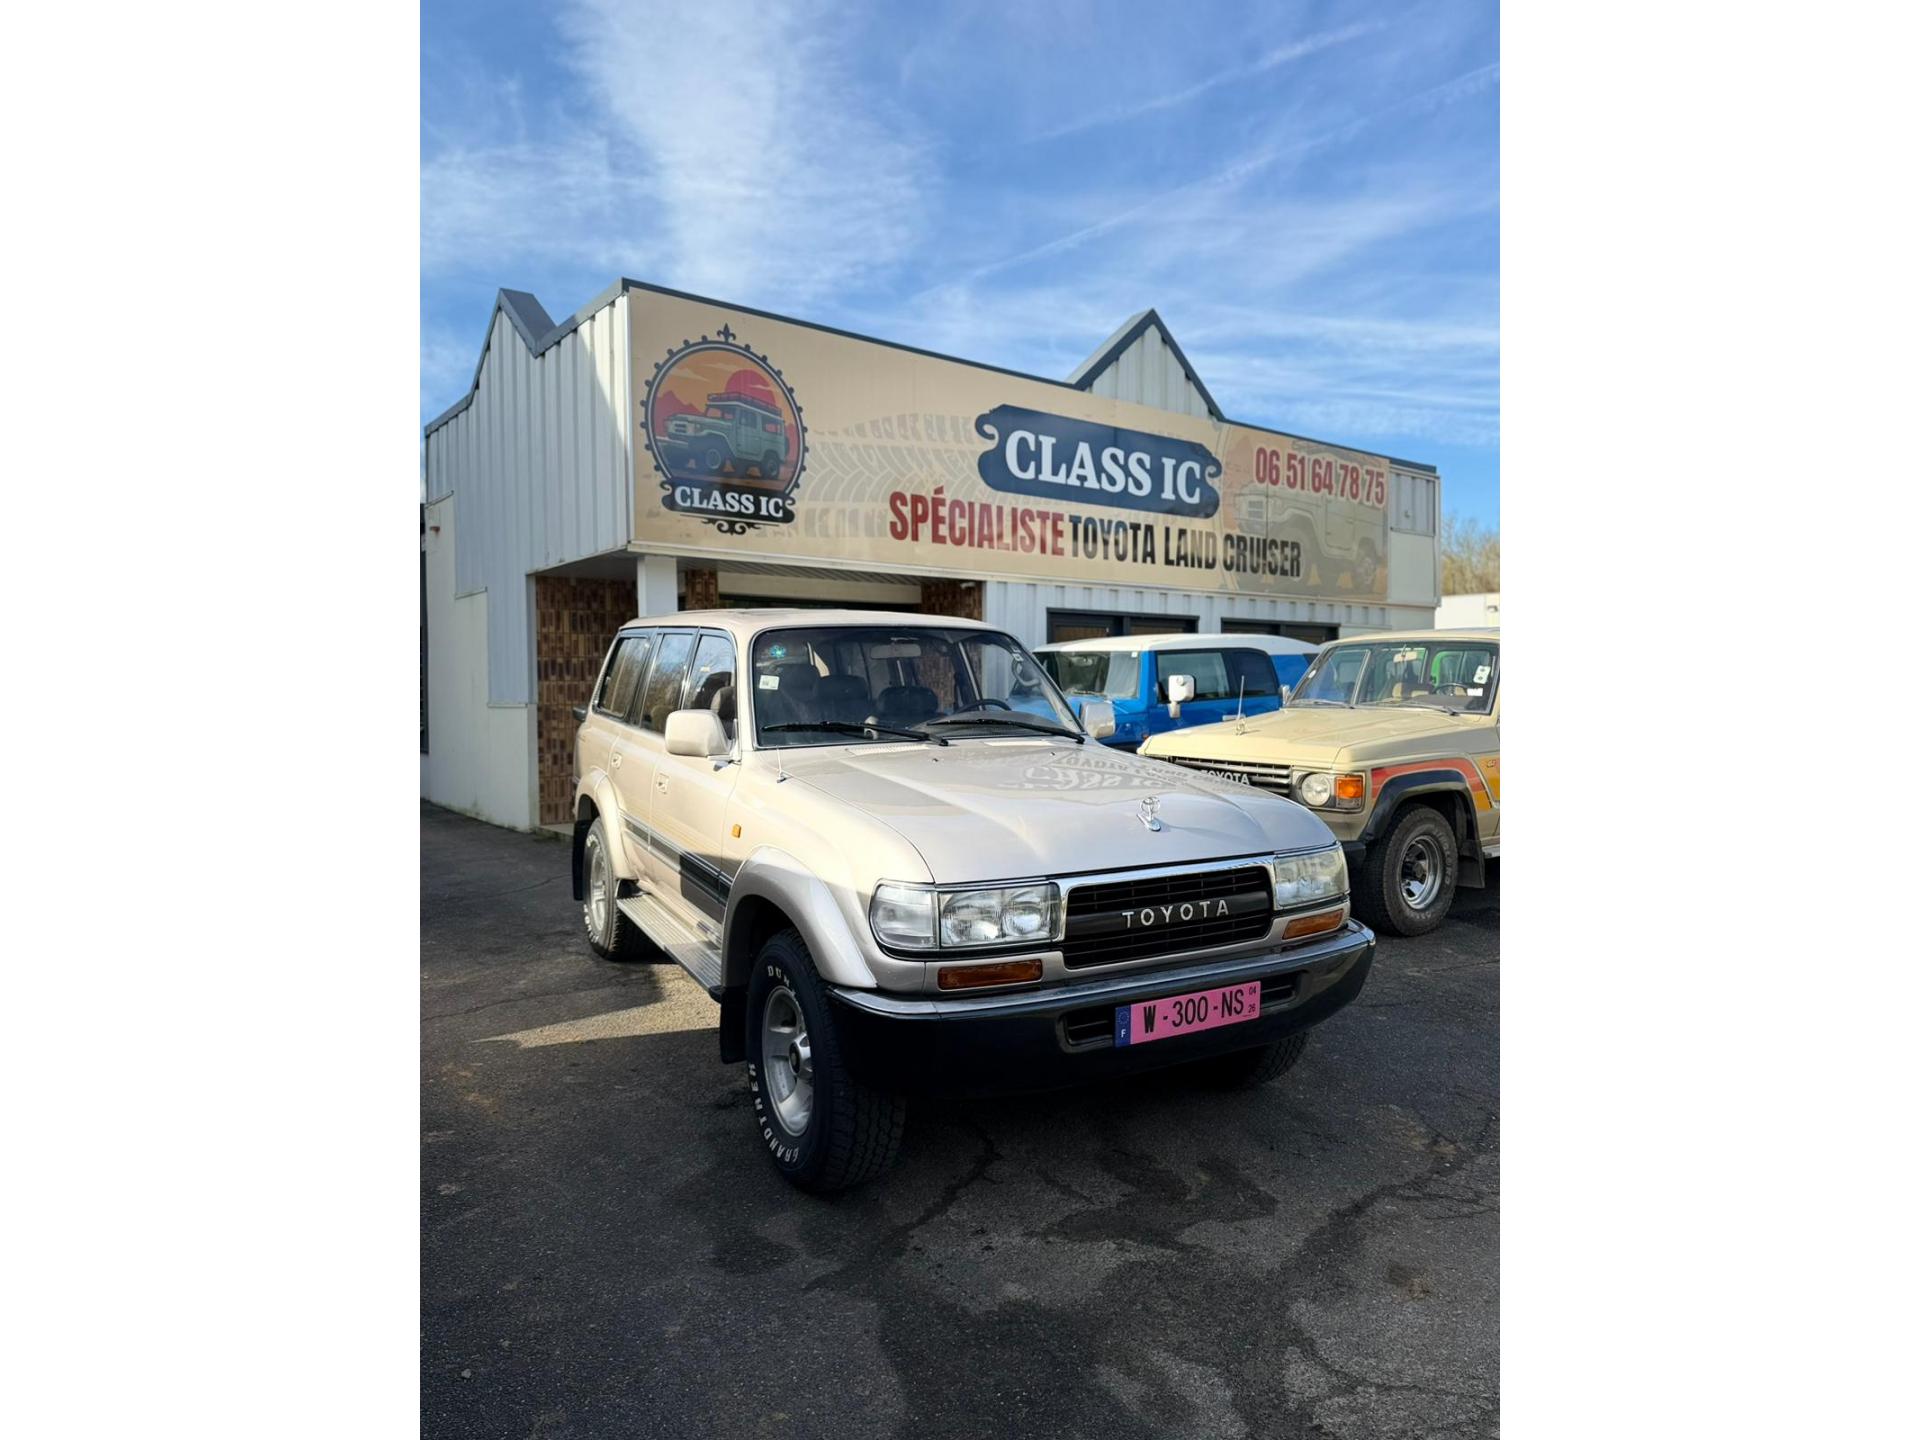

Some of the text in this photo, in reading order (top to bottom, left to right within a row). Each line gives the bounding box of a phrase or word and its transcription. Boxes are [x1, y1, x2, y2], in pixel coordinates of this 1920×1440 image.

[1005, 430, 1201, 505] CLASS IC
[1255, 447, 1385, 505] 06 51 64 78 75
[674, 486, 783, 517] CLASS IC
[889, 485, 1301, 577] SPÉCIALISTE TOYOTA LAND CRUISER
[1122, 899, 1229, 929] TOYOTA
[1120, 1028, 1127, 1038] F
